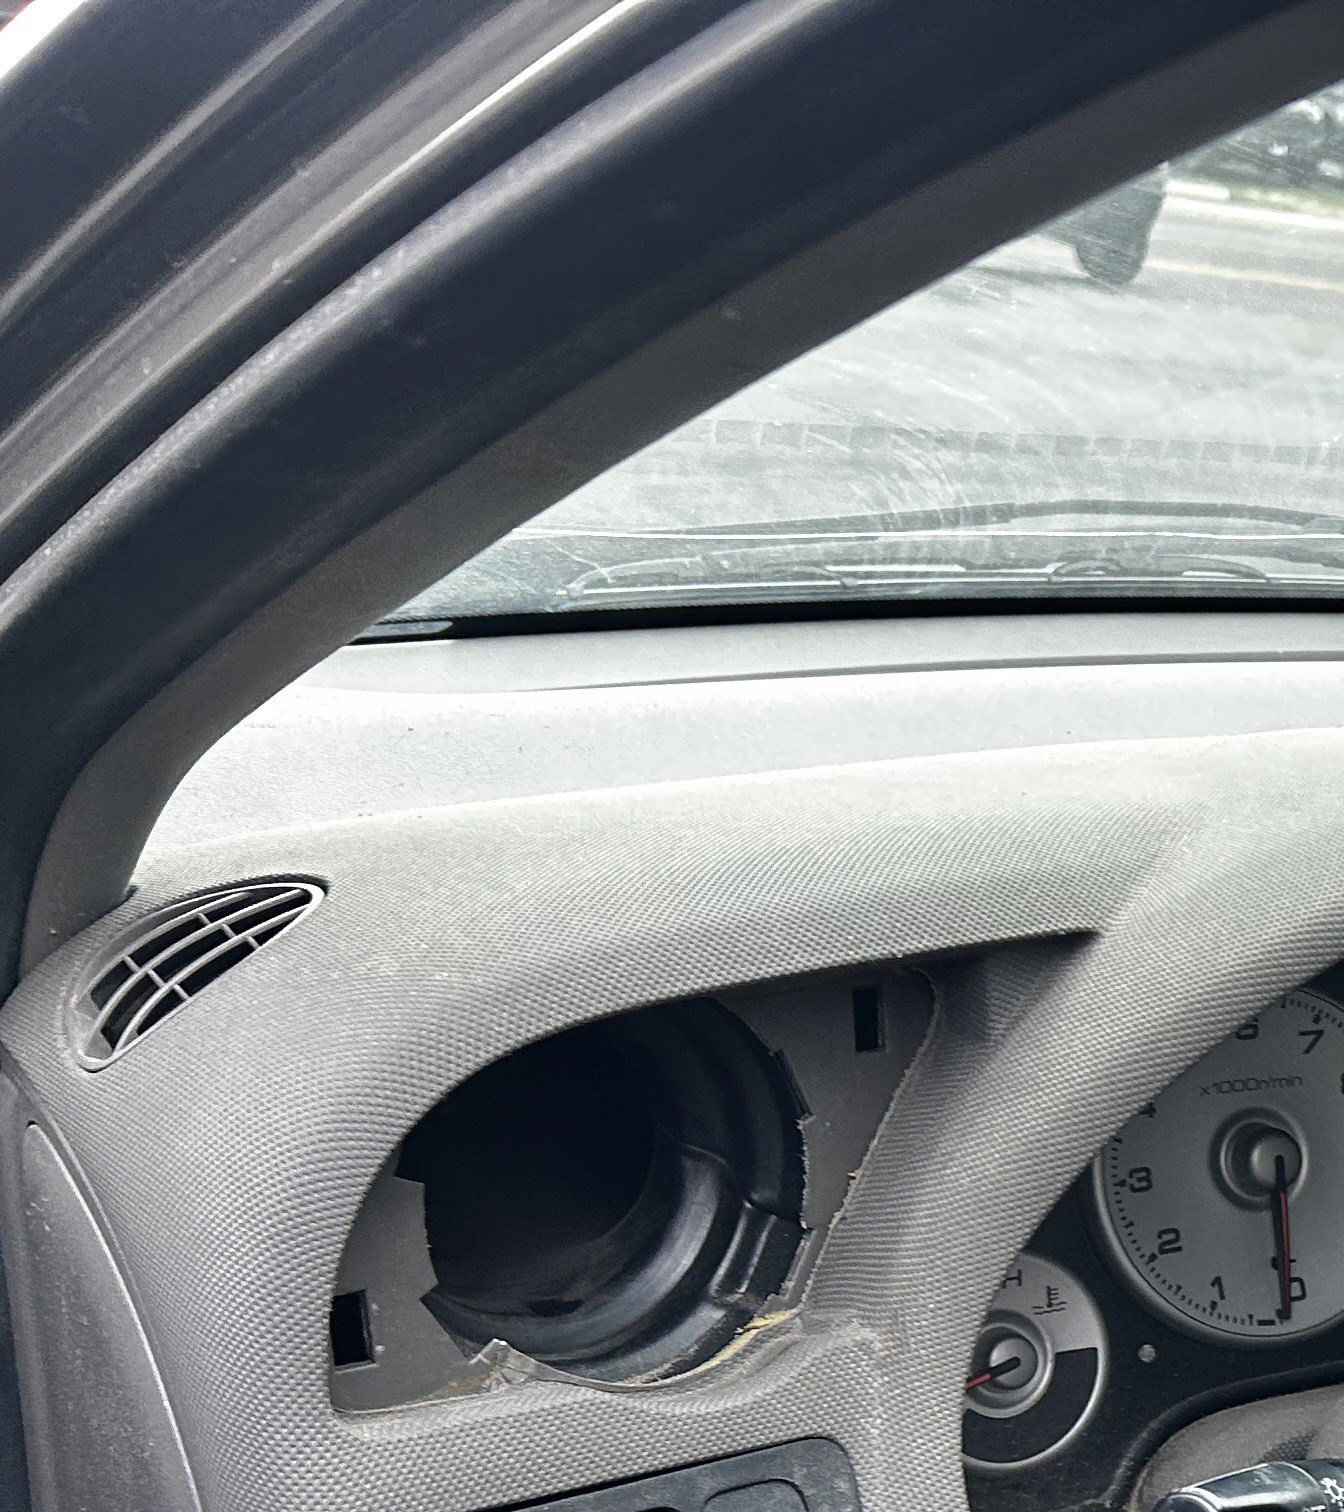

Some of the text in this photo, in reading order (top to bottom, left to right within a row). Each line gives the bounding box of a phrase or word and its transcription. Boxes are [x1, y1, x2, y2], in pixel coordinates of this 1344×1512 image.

[1299, 1029, 1325, 1054] 7
[1128, 1166, 1153, 1193] 3
[1157, 1227, 1183, 1255] 2
[1210, 1275, 1226, 1301] 1
